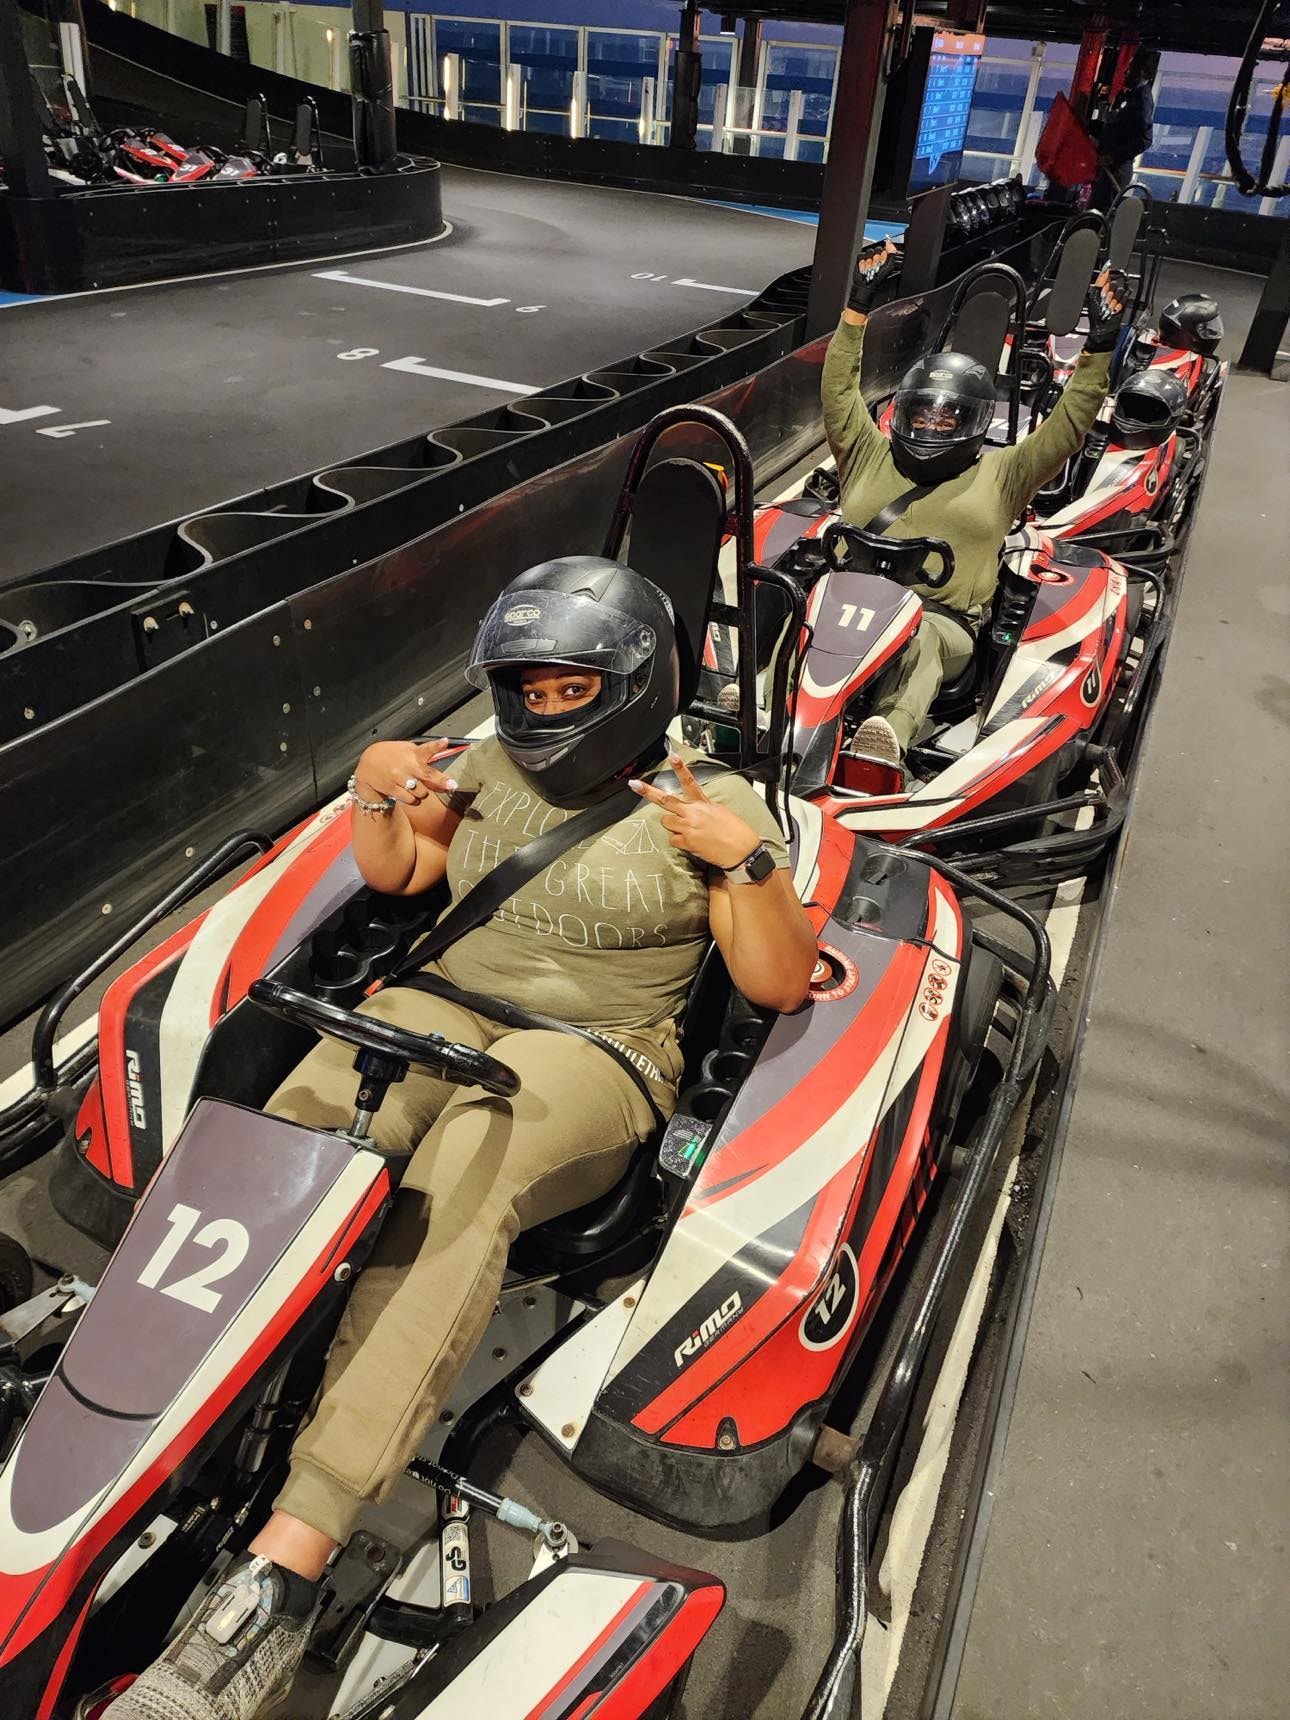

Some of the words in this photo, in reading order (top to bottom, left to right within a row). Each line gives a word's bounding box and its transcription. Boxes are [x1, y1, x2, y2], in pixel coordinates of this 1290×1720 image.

[336, 347, 380, 361] 8
[837, 603, 876, 631] 11
[463, 830, 520, 873] TH
[545, 860, 665, 913] GREAT
[137, 1203, 250, 1314] 12
[815, 1272, 846, 1325] 12
[703, 1305, 745, 1348] GERMANY
